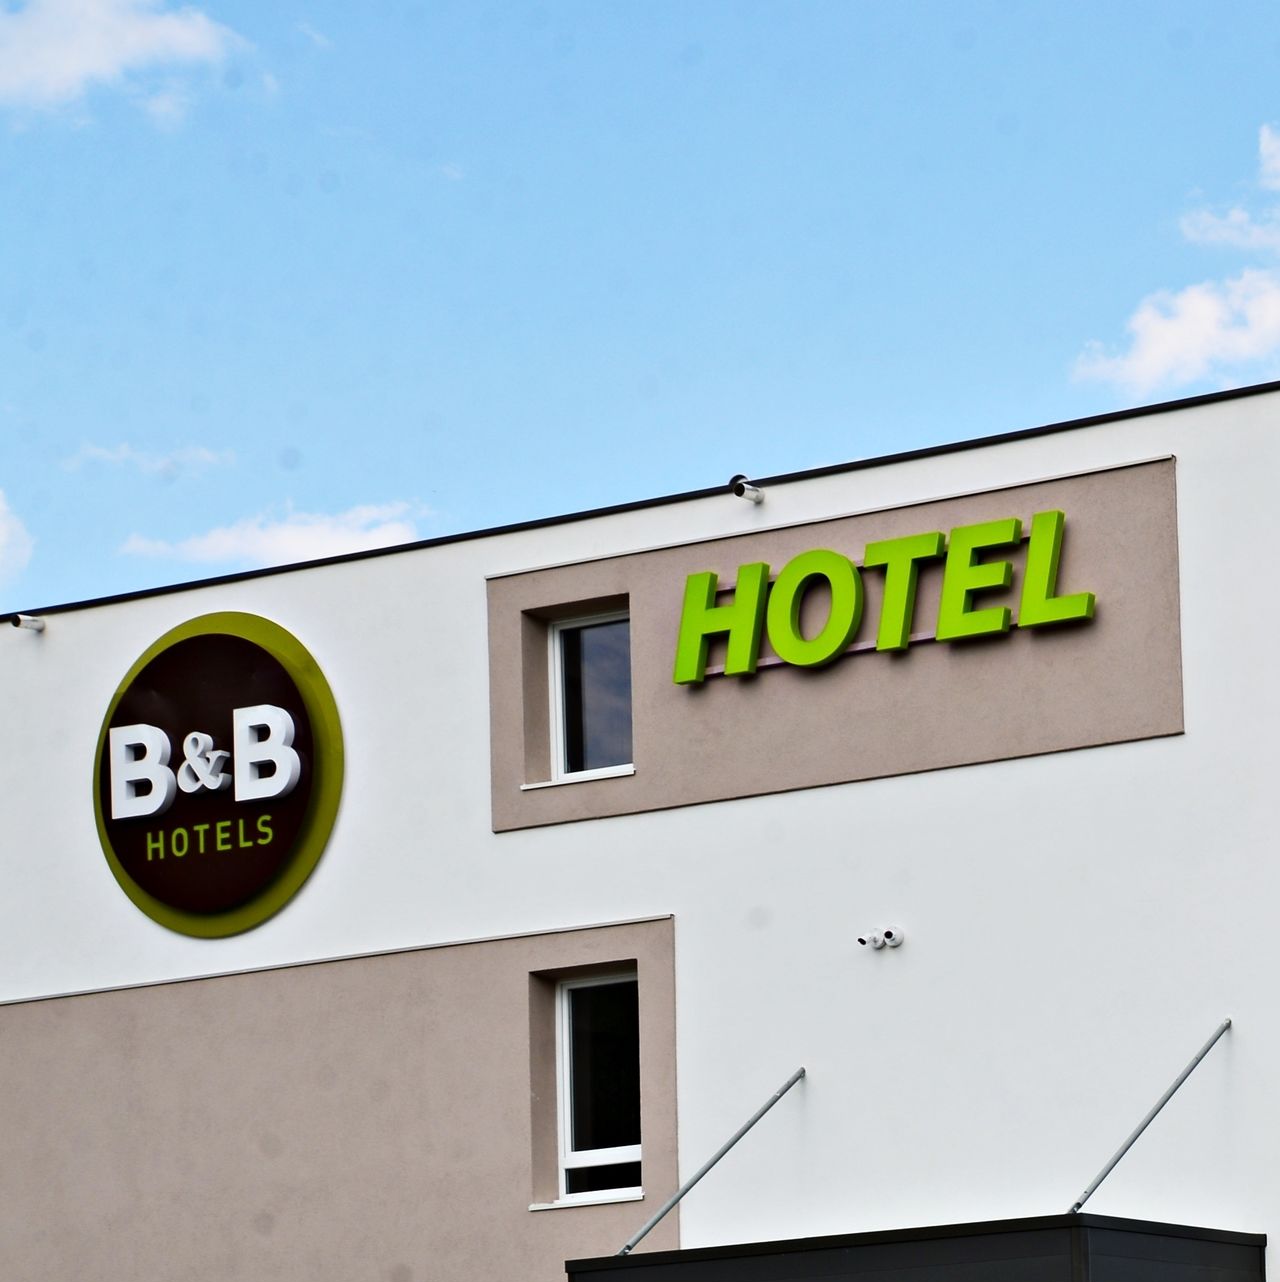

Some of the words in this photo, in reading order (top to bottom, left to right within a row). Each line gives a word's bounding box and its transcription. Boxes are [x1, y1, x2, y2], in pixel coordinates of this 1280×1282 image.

[673, 509, 1096, 685] HOTEL
[109, 704, 301, 820] B&B
[146, 815, 274, 861] HOTELS
